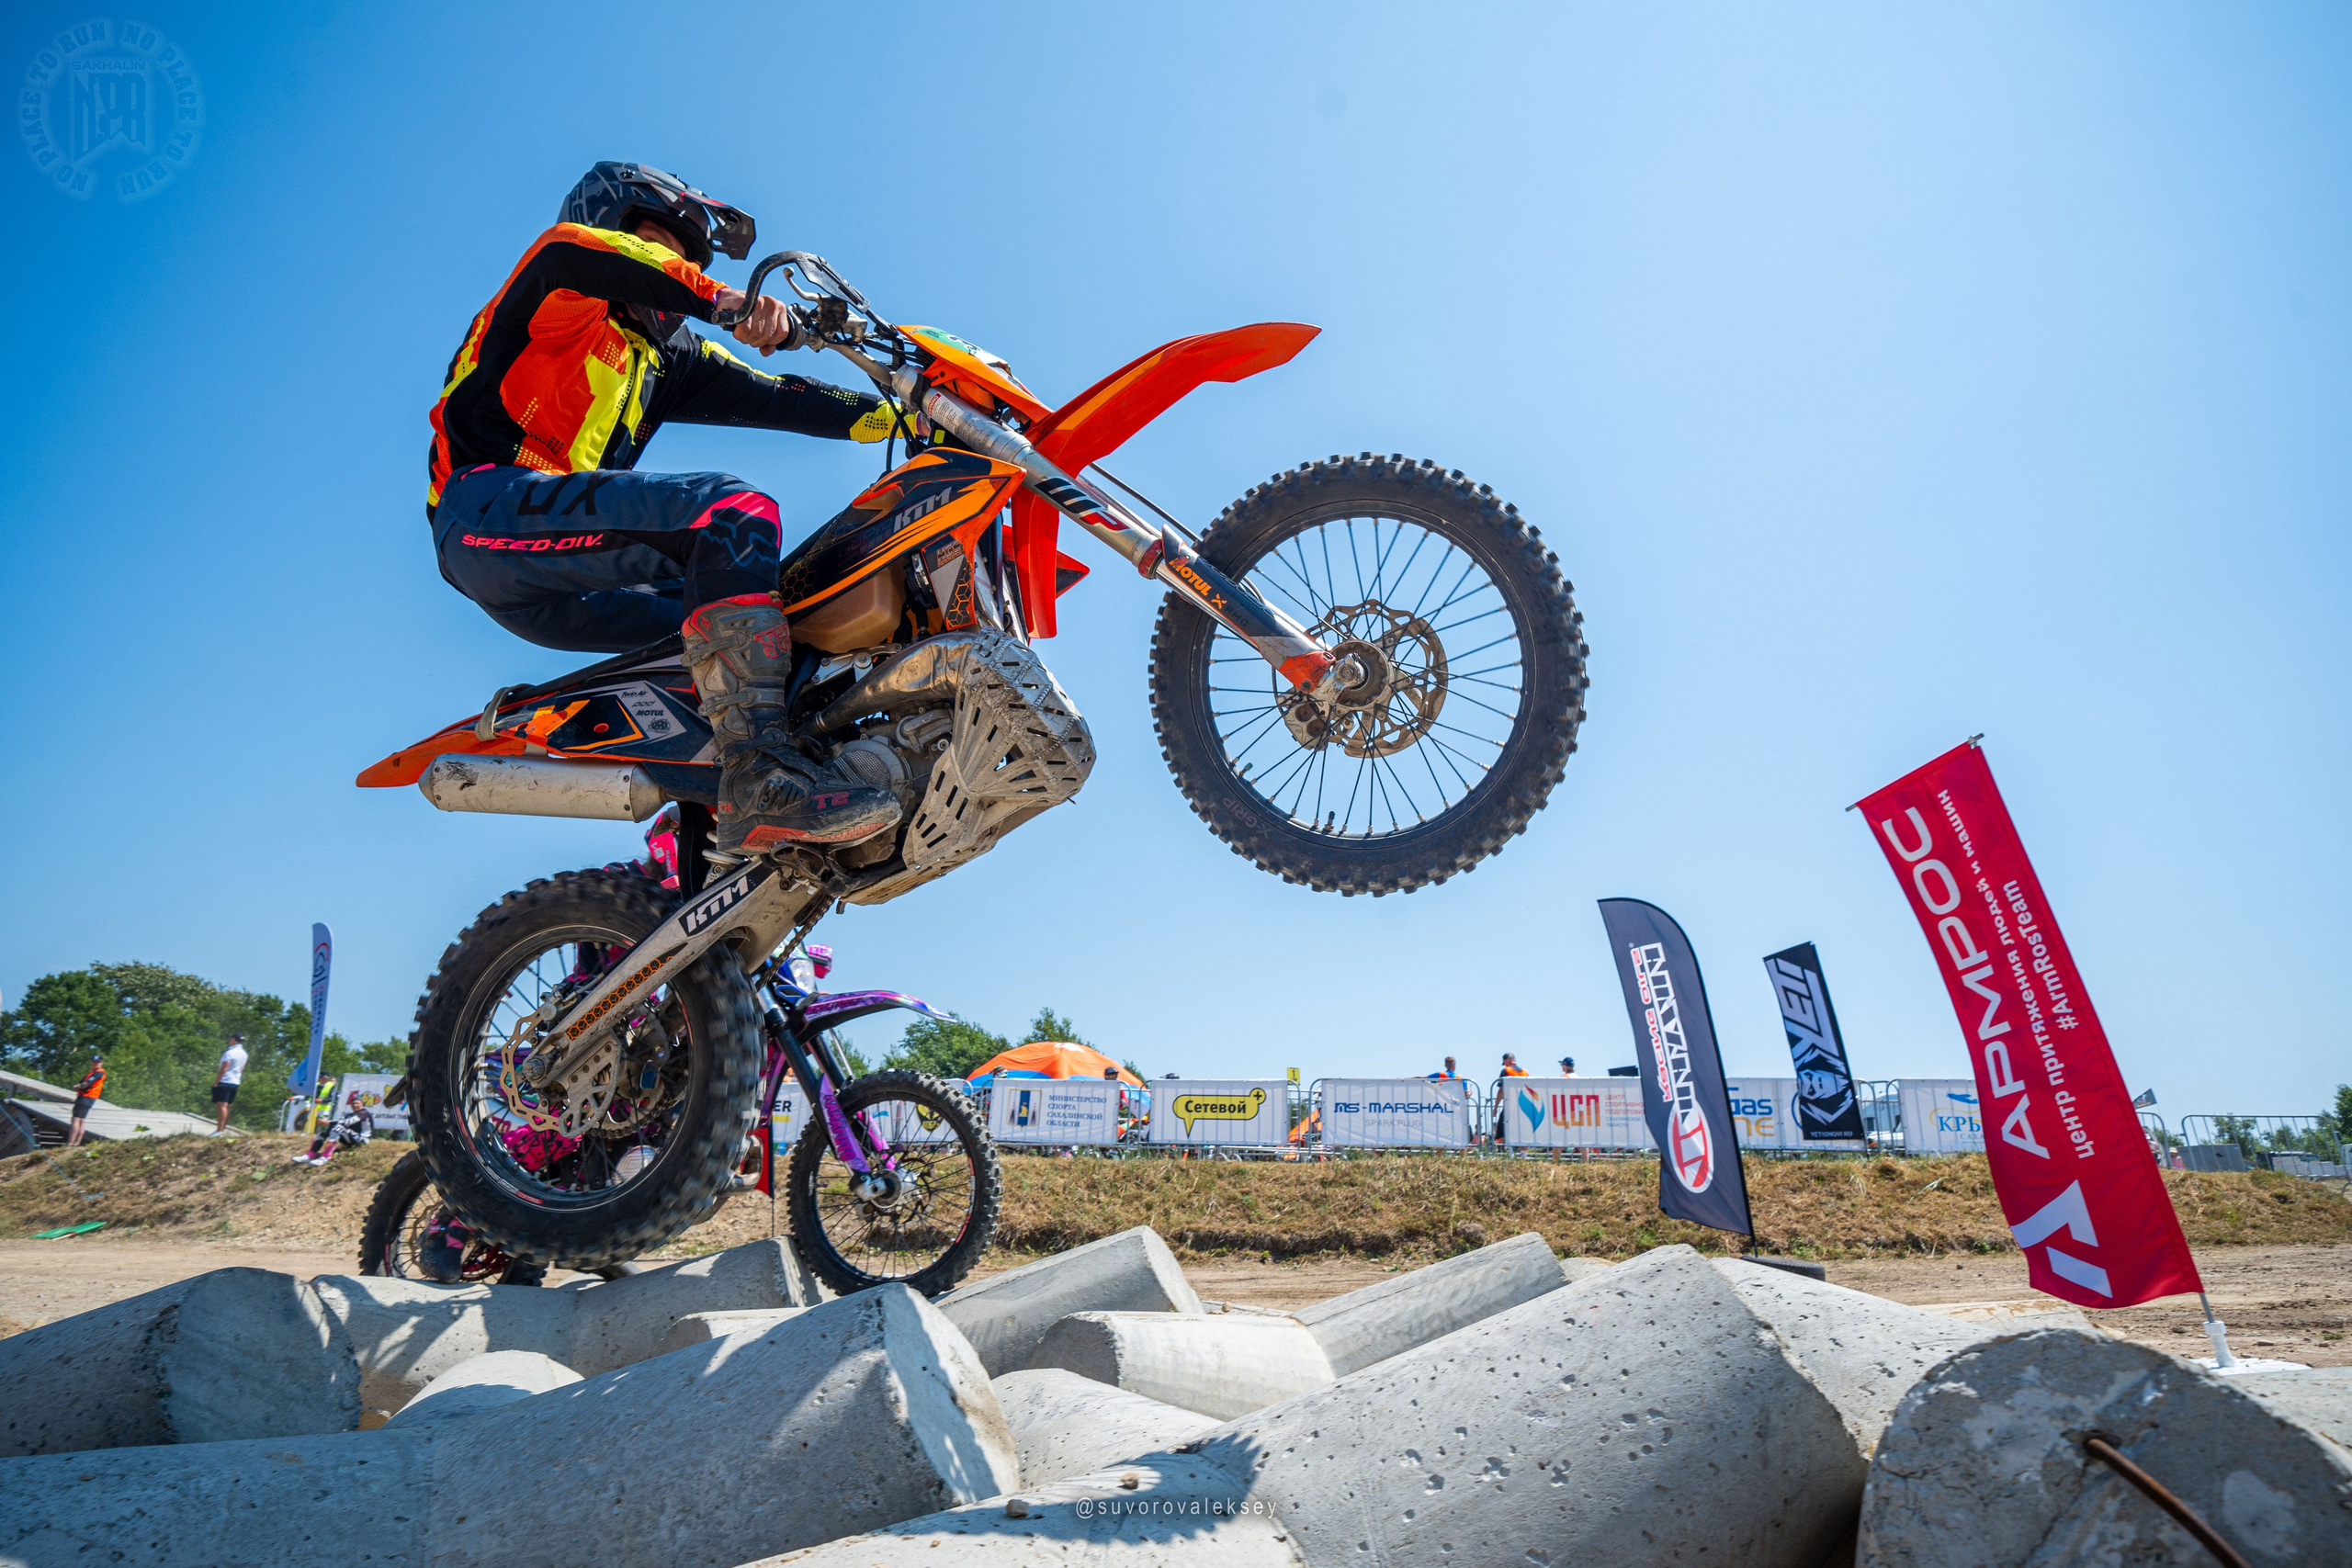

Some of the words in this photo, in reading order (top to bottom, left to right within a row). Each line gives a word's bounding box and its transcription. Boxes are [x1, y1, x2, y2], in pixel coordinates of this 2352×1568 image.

[893, 486, 953, 533] KTM
[1938, 789, 1975, 860] машин
[686, 875, 749, 933] KTM
[1976, 876, 2016, 947] людей
[2003, 880, 2078, 1031] #ArmRosTeam
[1883, 806, 2051, 1160] АРМРОС
[2007, 951, 2067, 1088] притяжения
[1046, 1111, 1103, 1121] САХАЛИНСКОЙ
[1046, 1120, 1080, 1128] ОБЛАСТИ
[1049, 1095, 1107, 1103] МИНИСТЕРСТВО
[1184, 1100, 1247, 1114] Сетевой
[1364, 1119, 1396, 1127] SPARK
[1396, 1119, 1422, 1128] PLUG
[1552, 1094, 1601, 1129] ЦСП
[2053, 1086, 2096, 1159] центр
